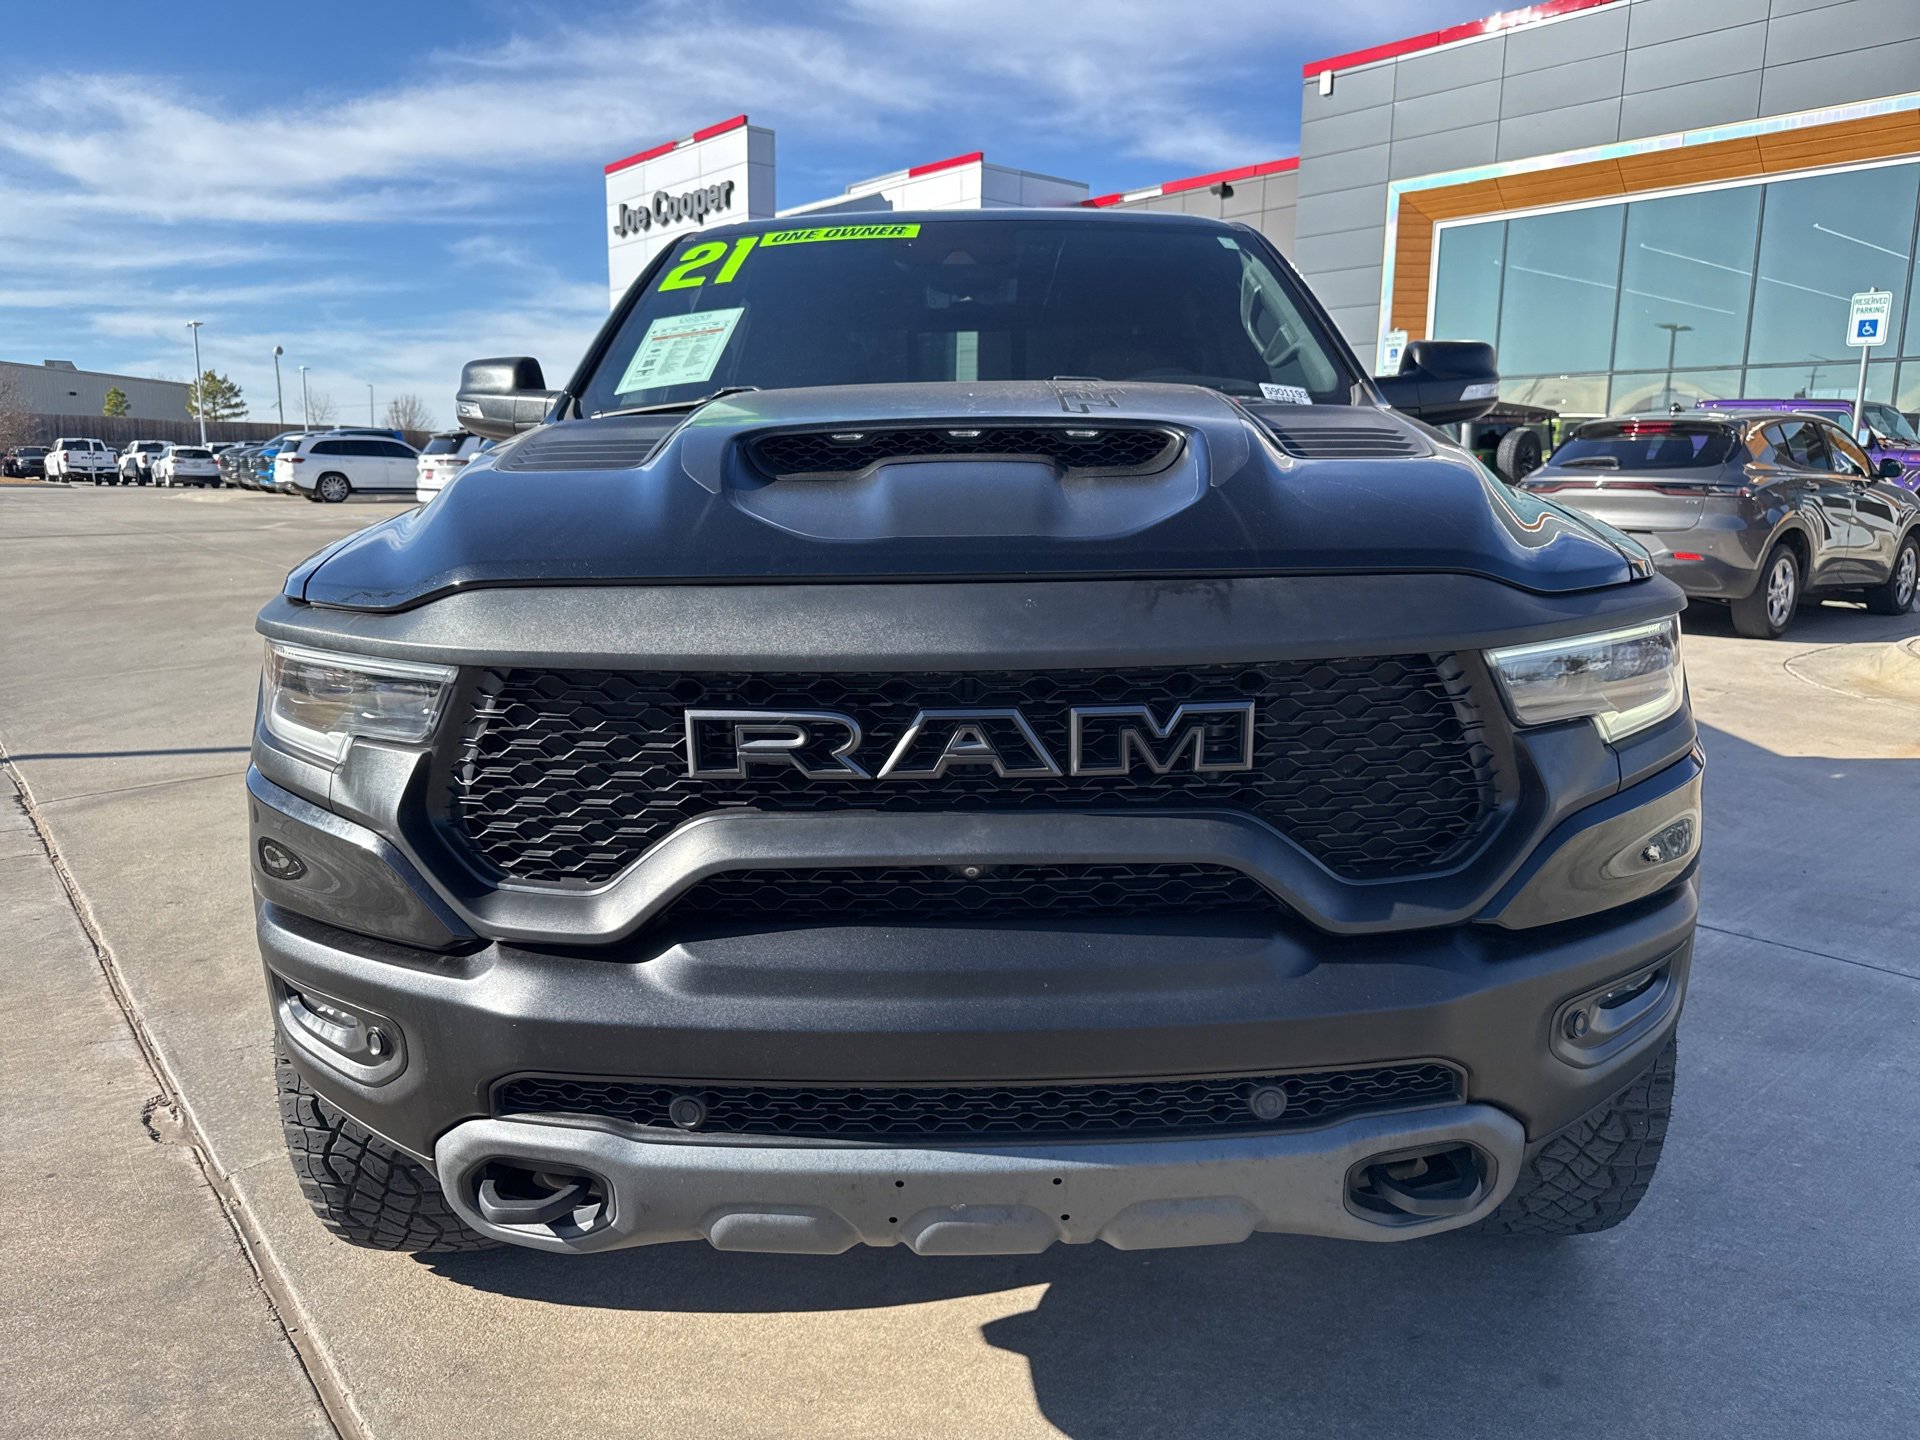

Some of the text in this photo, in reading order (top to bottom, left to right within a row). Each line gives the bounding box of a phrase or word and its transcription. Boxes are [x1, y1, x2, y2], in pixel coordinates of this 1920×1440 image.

[613, 180, 735, 238] Joe Cooper
[771, 226, 908, 243] ONE OWNER
[658, 236, 759, 292] 21
[1855, 297, 1888, 305] RESERVED
[1856, 306, 1884, 314] PARKING
[684, 700, 1256, 780] RAM
